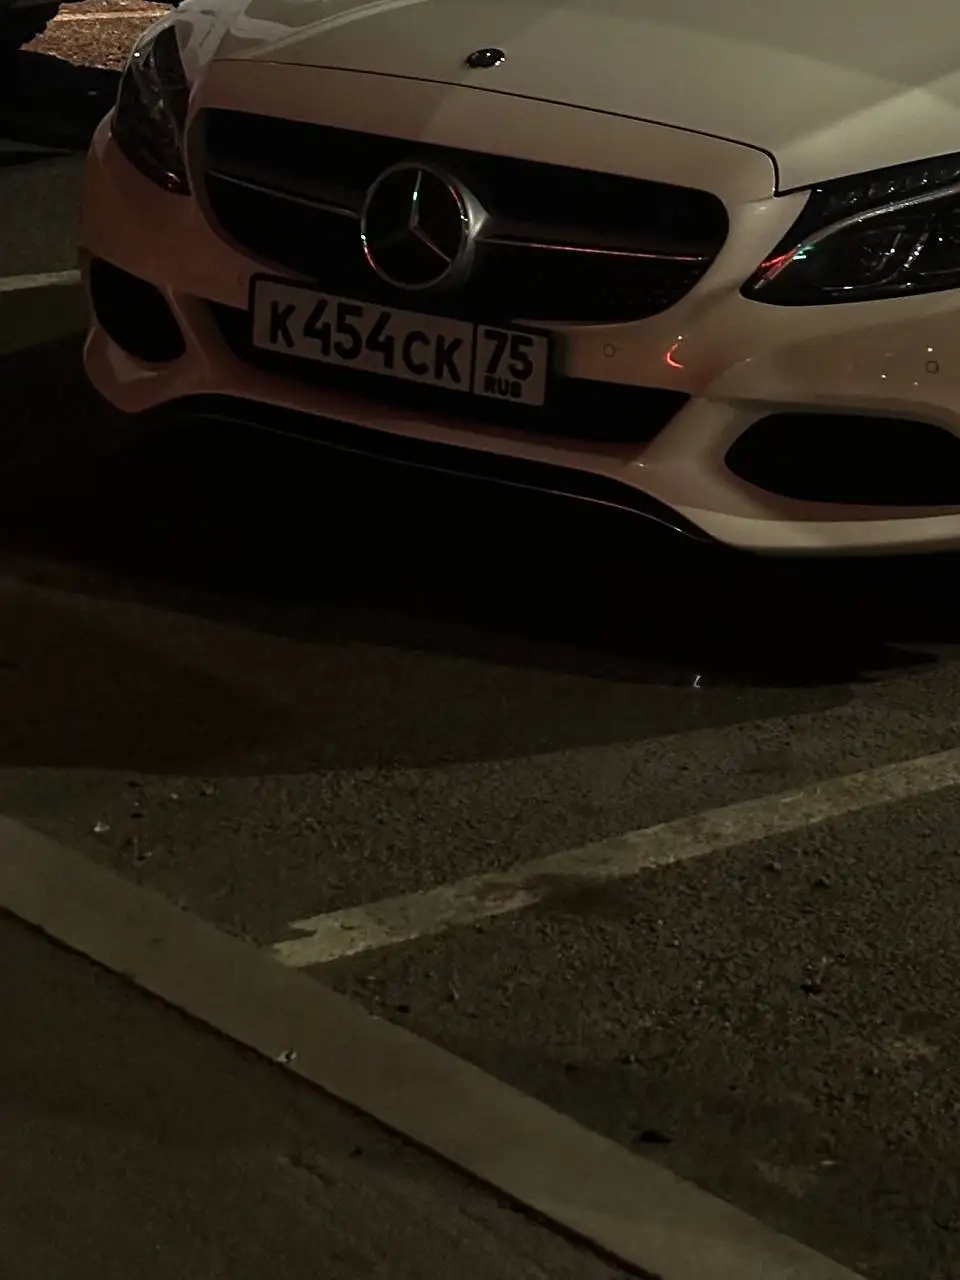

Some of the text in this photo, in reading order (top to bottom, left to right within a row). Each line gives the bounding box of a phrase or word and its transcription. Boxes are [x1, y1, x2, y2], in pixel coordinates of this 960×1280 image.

[269, 298, 463, 384] К454СК
[483, 328, 534, 381] 75
[484, 377, 523, 399] RUS
